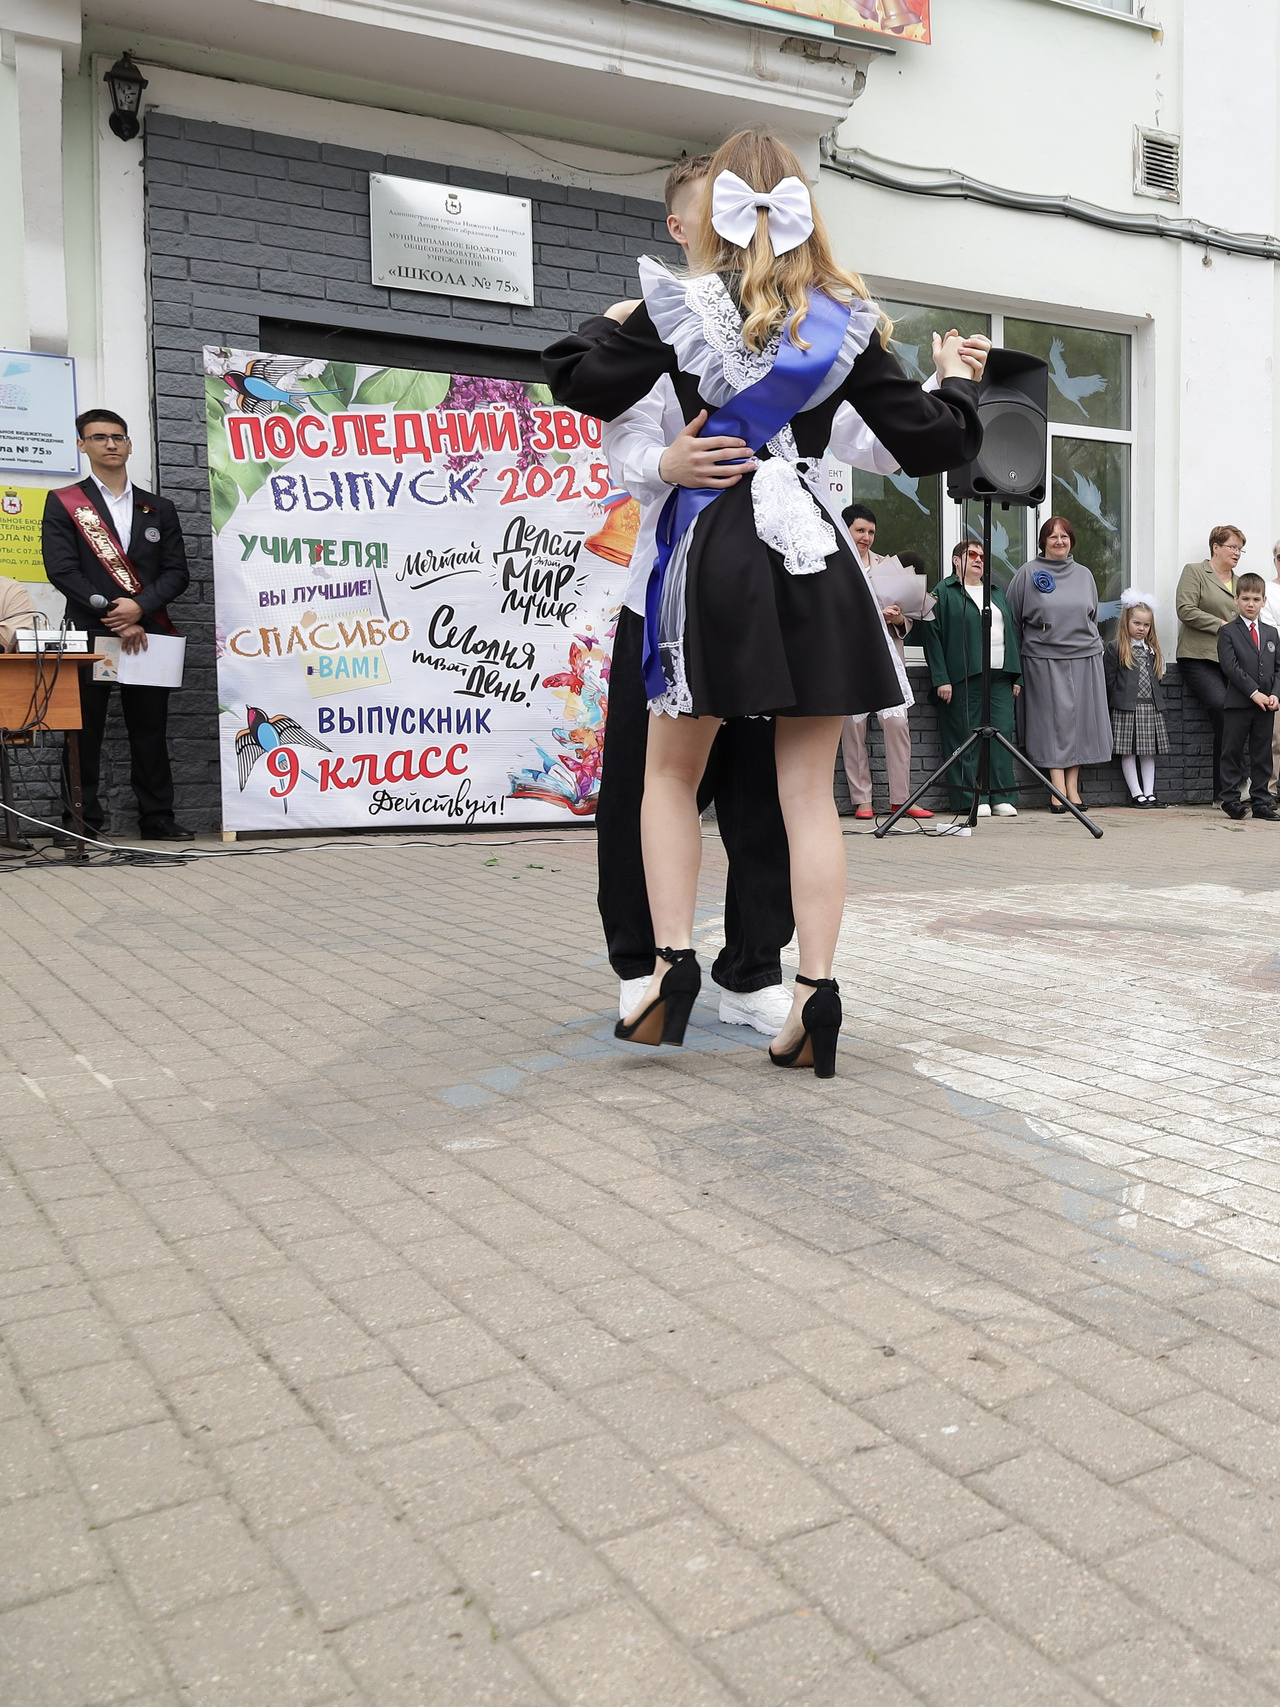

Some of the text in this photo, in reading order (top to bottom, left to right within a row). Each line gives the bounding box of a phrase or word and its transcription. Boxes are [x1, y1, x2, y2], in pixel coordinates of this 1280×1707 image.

[388, 232, 518, 257] МУНИЦИПАЛЬНОЕ БЮДЖЕТНОЕ
[417, 221, 499, 239] Департамент образования
[463, 220, 492, 231] Нижнего
[493, 225, 526, 237] Новгорода
[403, 242, 504, 263] ОБЩЕОБРАЗОВАТЕЛЬНОЕ
[427, 254, 482, 268] УЧРЕЖДЕНИЕ
[388, 265, 519, 294] «ШКОЛА № 75»
[16, 446, 29, 454] №
[32, 446, 52, 455] 75»
[227, 406, 602, 463] ПОСЛЕДНИЙ ЗВО
[271, 463, 610, 513] ВЫПУСК 2025
[238, 534, 389, 570] УЧИТЕЛЯ!
[493, 515, 586, 564] Делай
[396, 541, 486, 582] Мечтай
[259, 579, 373, 608] ВЫ ЛУЧШИЕ!
[503, 557, 575, 602] Мир
[229, 618, 411, 658] СПАСИБО
[428, 604, 537, 671] Сегодня
[319, 656, 380, 680] ВАМ!
[318, 706, 492, 735] ВЫПУСКНИК
[266, 743, 469, 798] 9 класс
[368, 778, 506, 825] Действуй!
